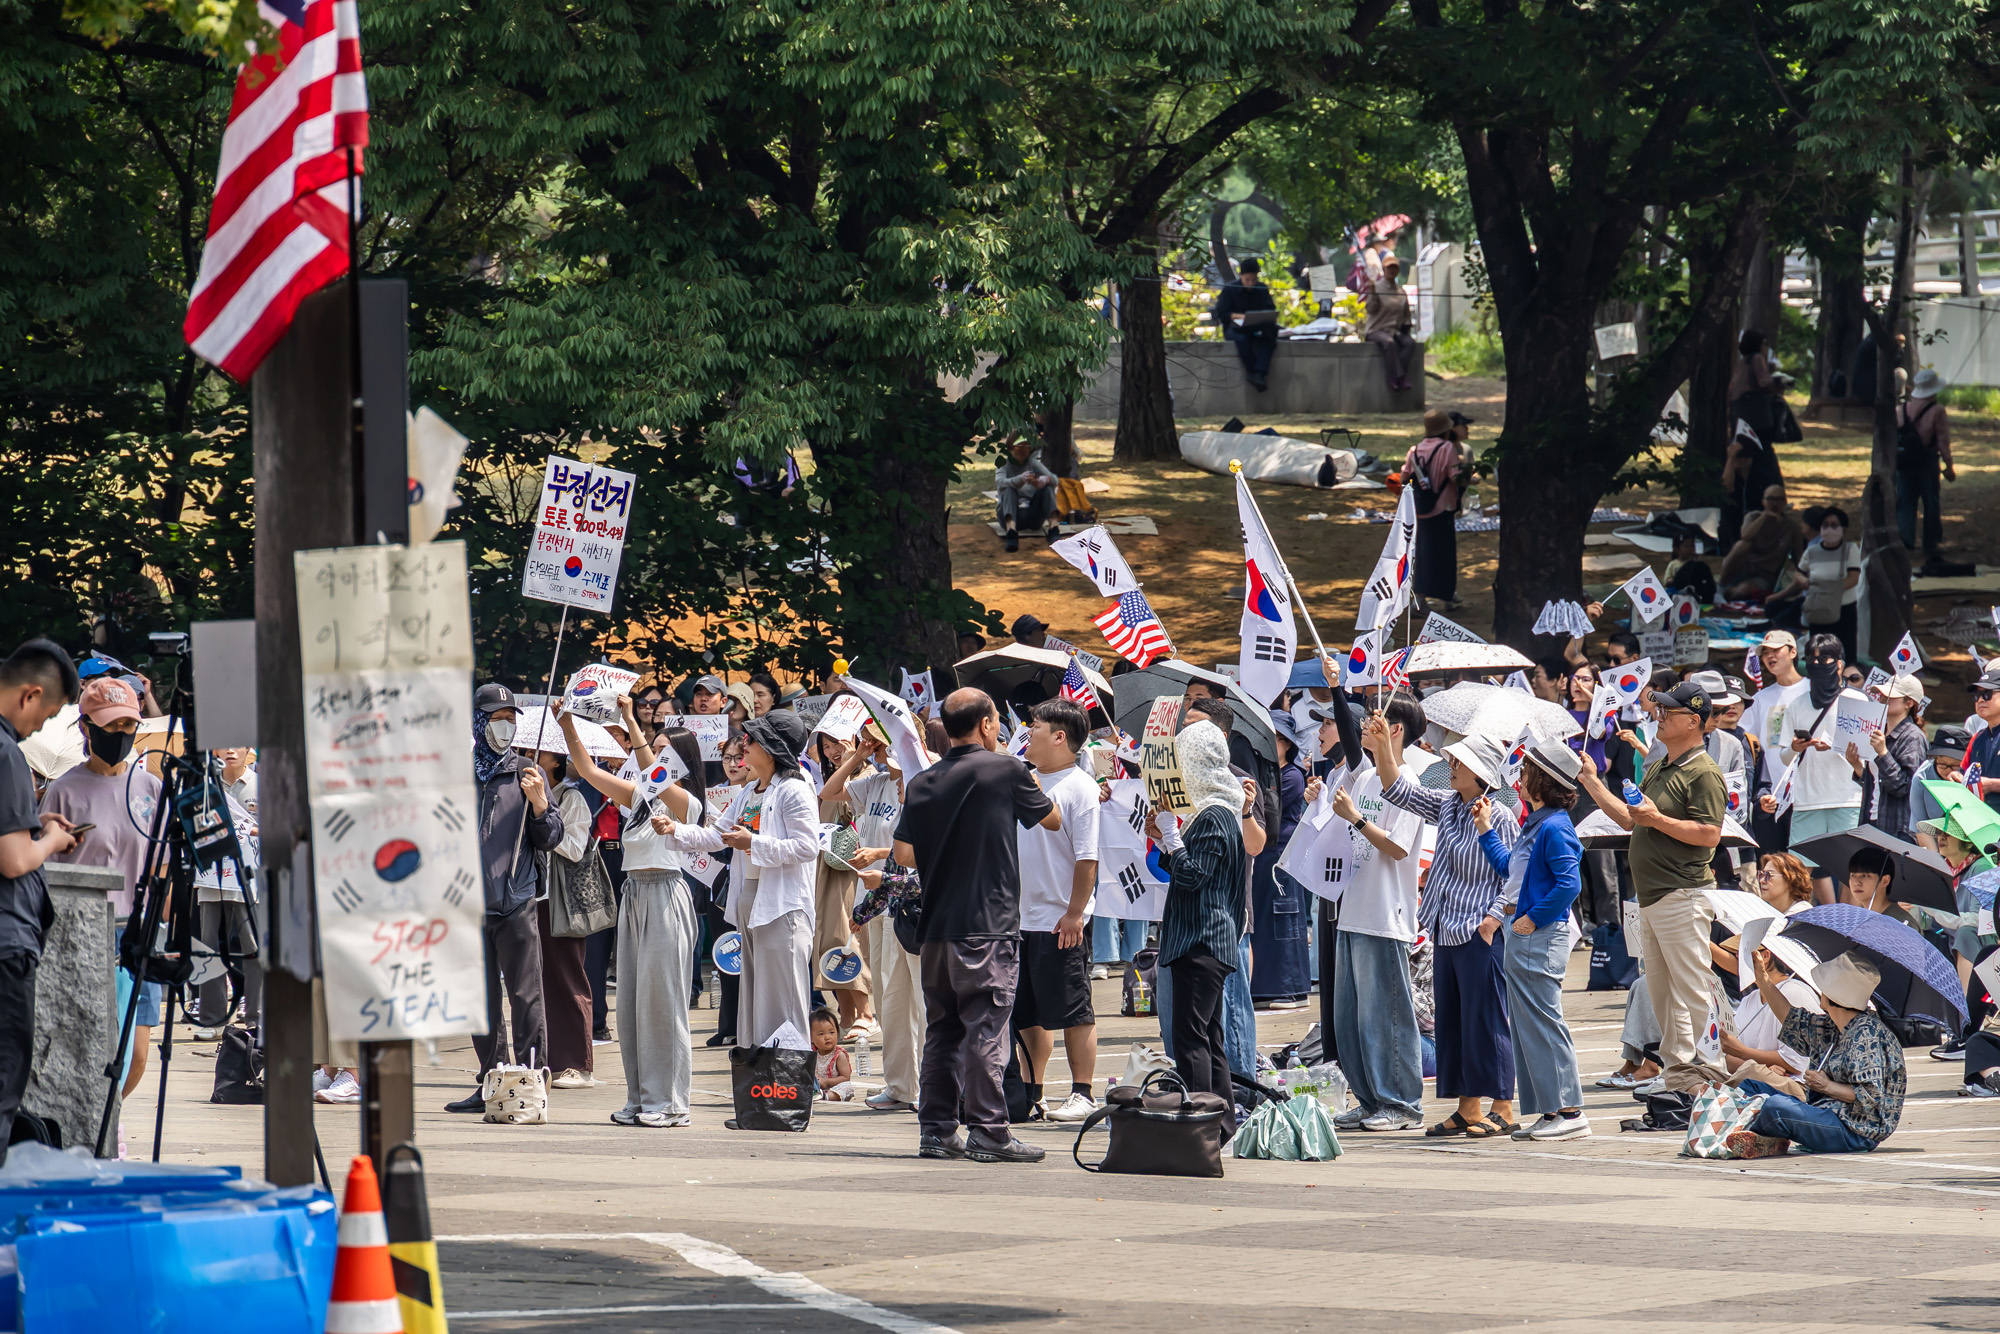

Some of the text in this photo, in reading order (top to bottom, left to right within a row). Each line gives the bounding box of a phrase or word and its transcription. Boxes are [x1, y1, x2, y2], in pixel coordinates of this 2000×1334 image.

[547, 464, 632, 518] 부정선거
[537, 530, 614, 563] 부정선거 재선거
[529, 560, 612, 591] 당일투표 수개표
[548, 583, 565, 593] STOP
[568, 587, 579, 596] THE
[499, 687, 507, 701] B
[1142, 742, 1178, 770] 재선거
[370, 917, 449, 966] STOP
[389, 961, 436, 990] THE
[360, 990, 468, 1034] STEAL
[508, 1089, 515, 1098] 5
[519, 1077, 527, 1086] 4
[750, 1081, 798, 1100] coles
[498, 1099, 546, 1111] 9 2 3
